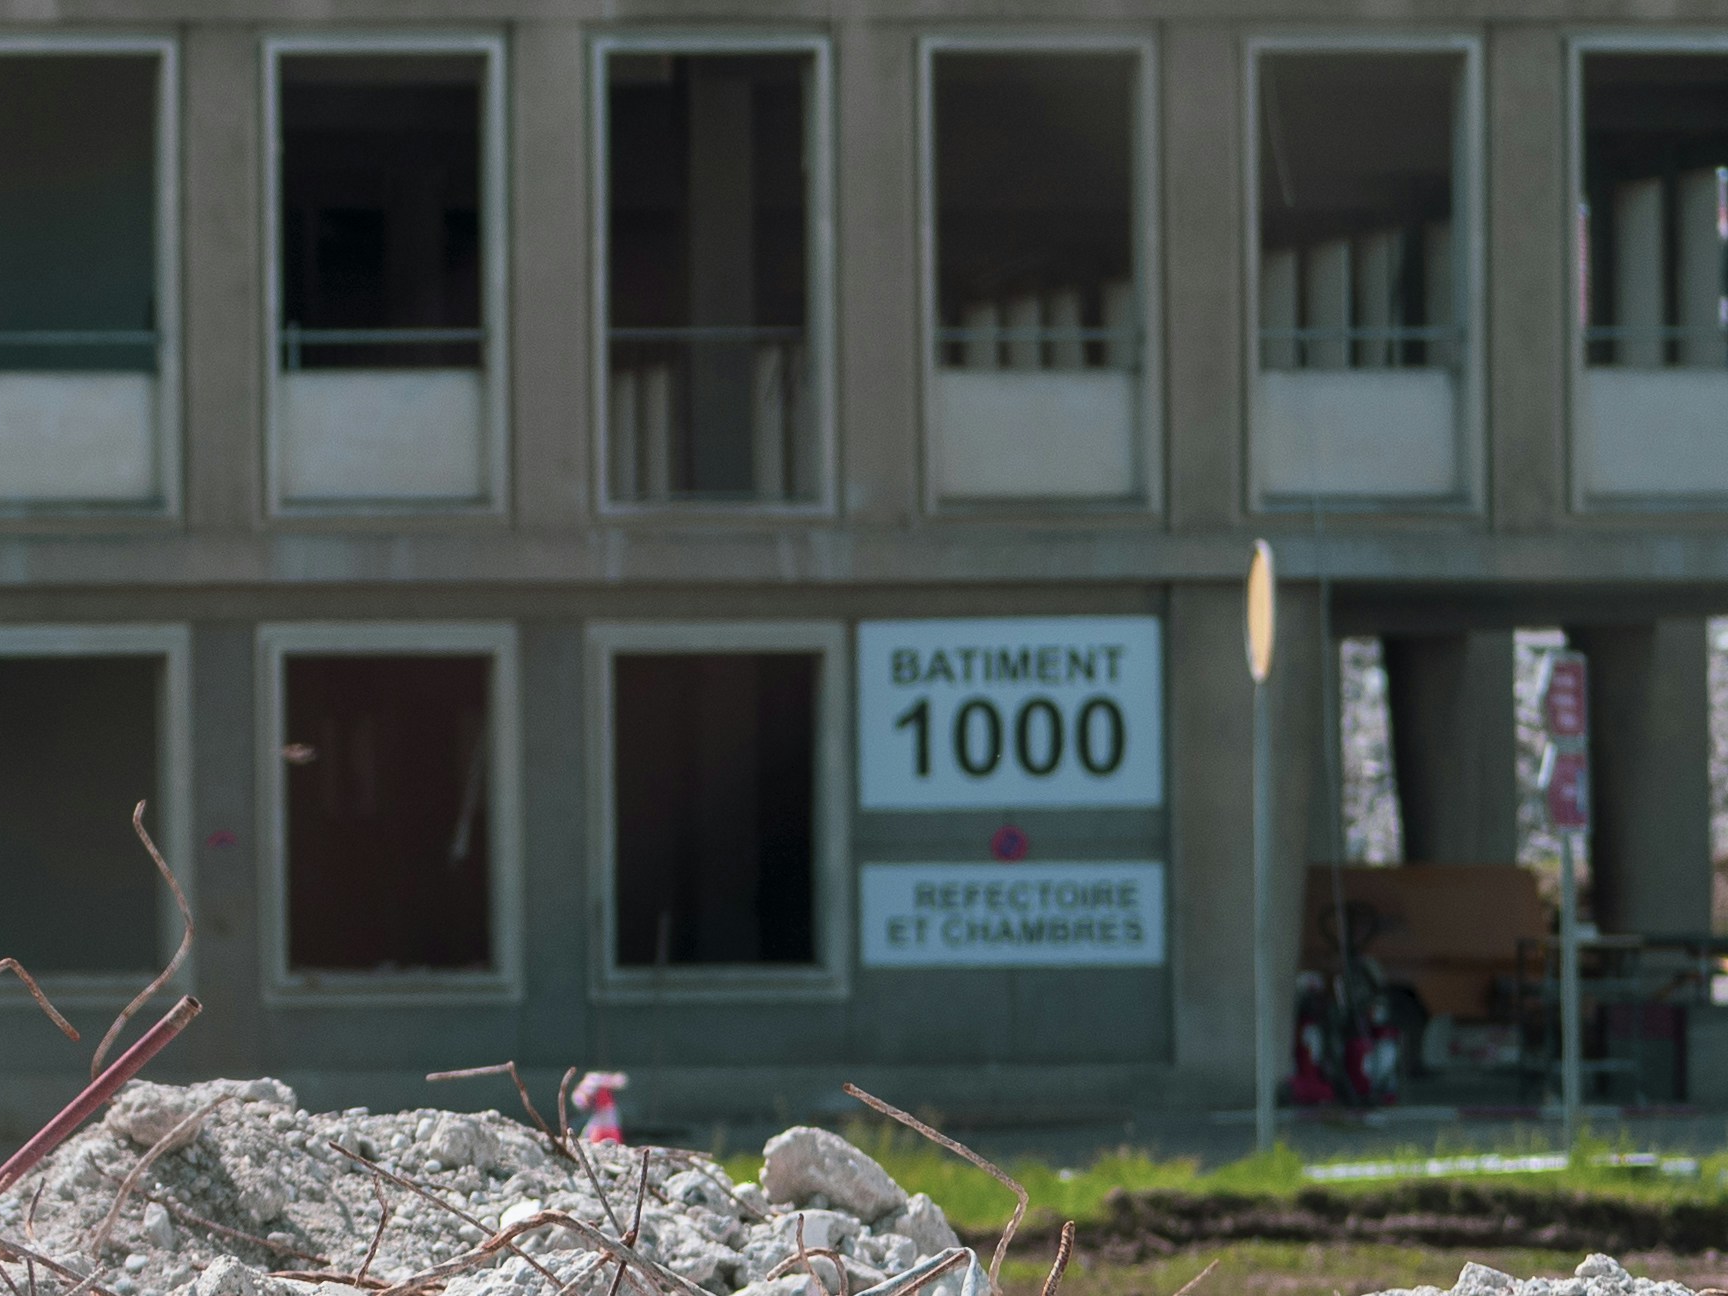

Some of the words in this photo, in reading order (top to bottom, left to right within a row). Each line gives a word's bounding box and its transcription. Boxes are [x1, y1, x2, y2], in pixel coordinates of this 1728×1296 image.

[891, 645, 1127, 684] BATIMENT
[895, 696, 1127, 778] 1000
[887, 917, 930, 947] ET
[941, 915, 1143, 947] CHAMBRES
